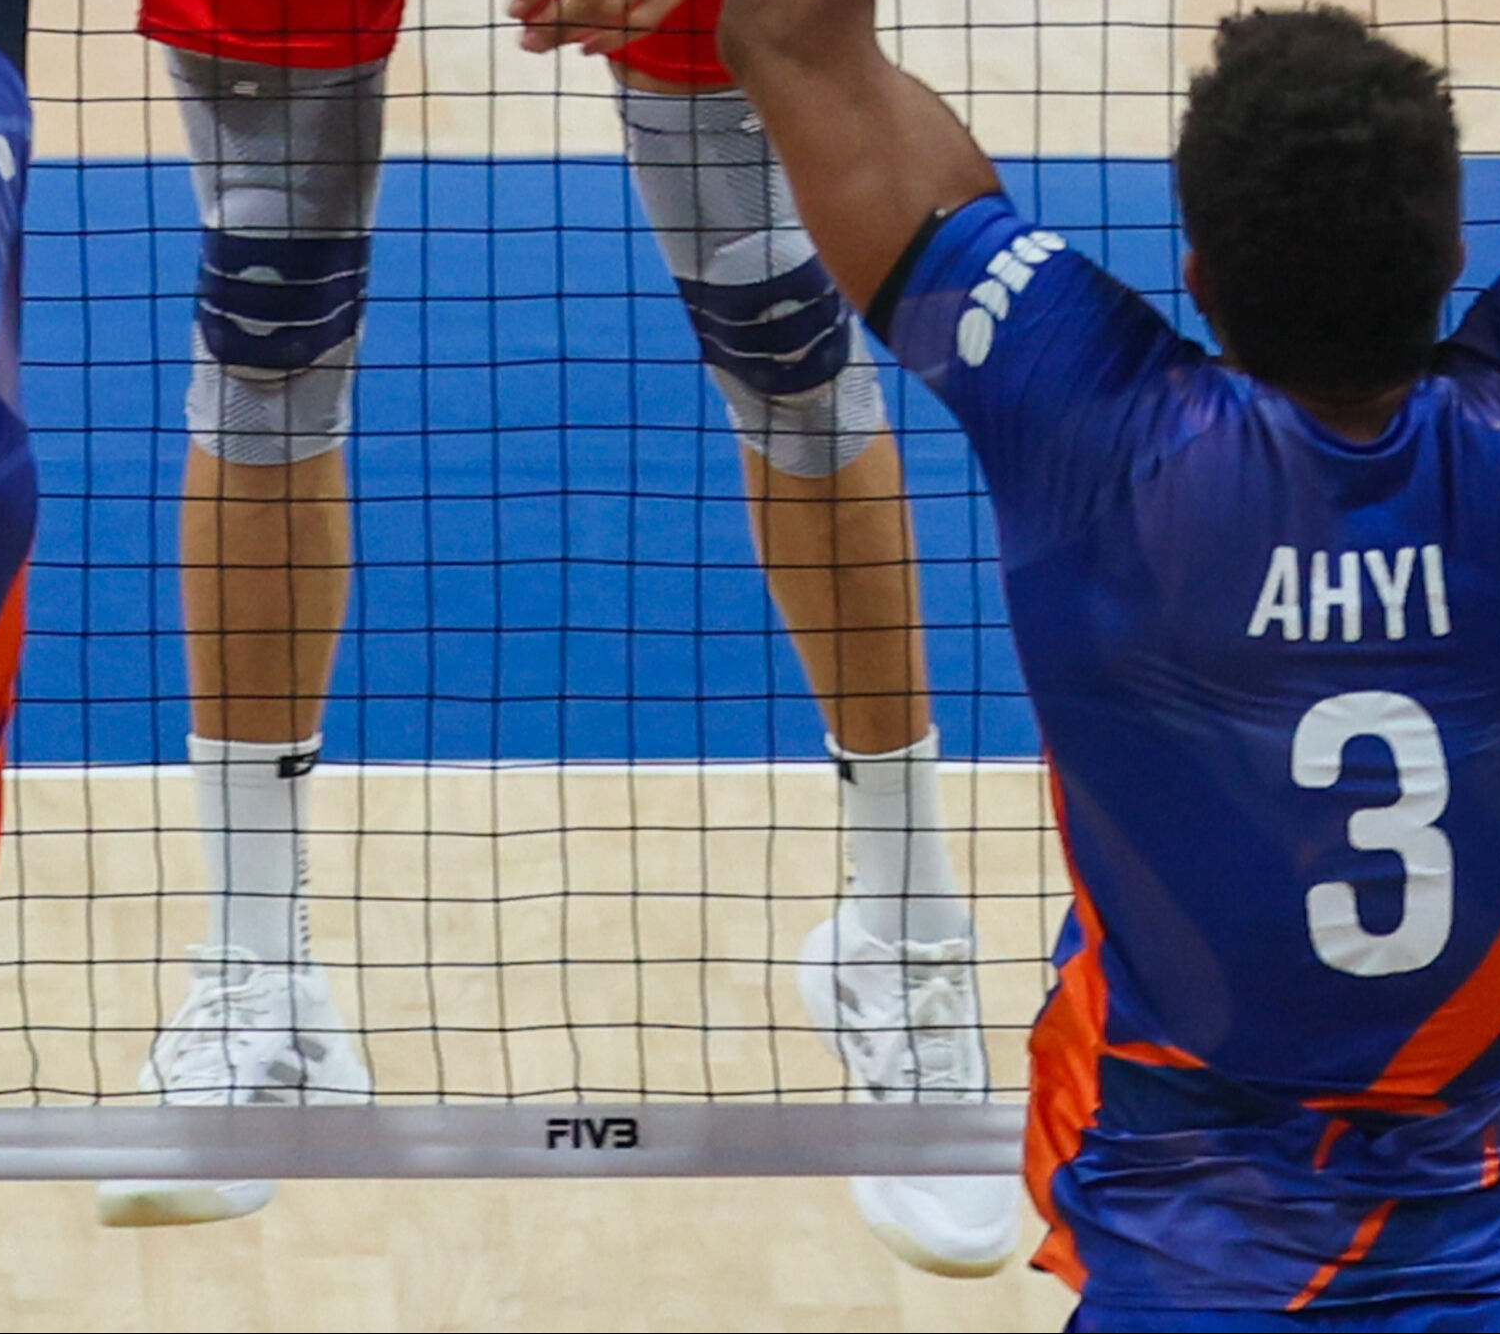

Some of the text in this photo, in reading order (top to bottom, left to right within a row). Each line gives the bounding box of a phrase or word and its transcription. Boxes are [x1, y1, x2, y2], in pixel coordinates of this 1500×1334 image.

[1246, 544, 1452, 642] AHYI
[1291, 690, 1453, 977] 3
[546, 1118, 638, 1149] FIVB
